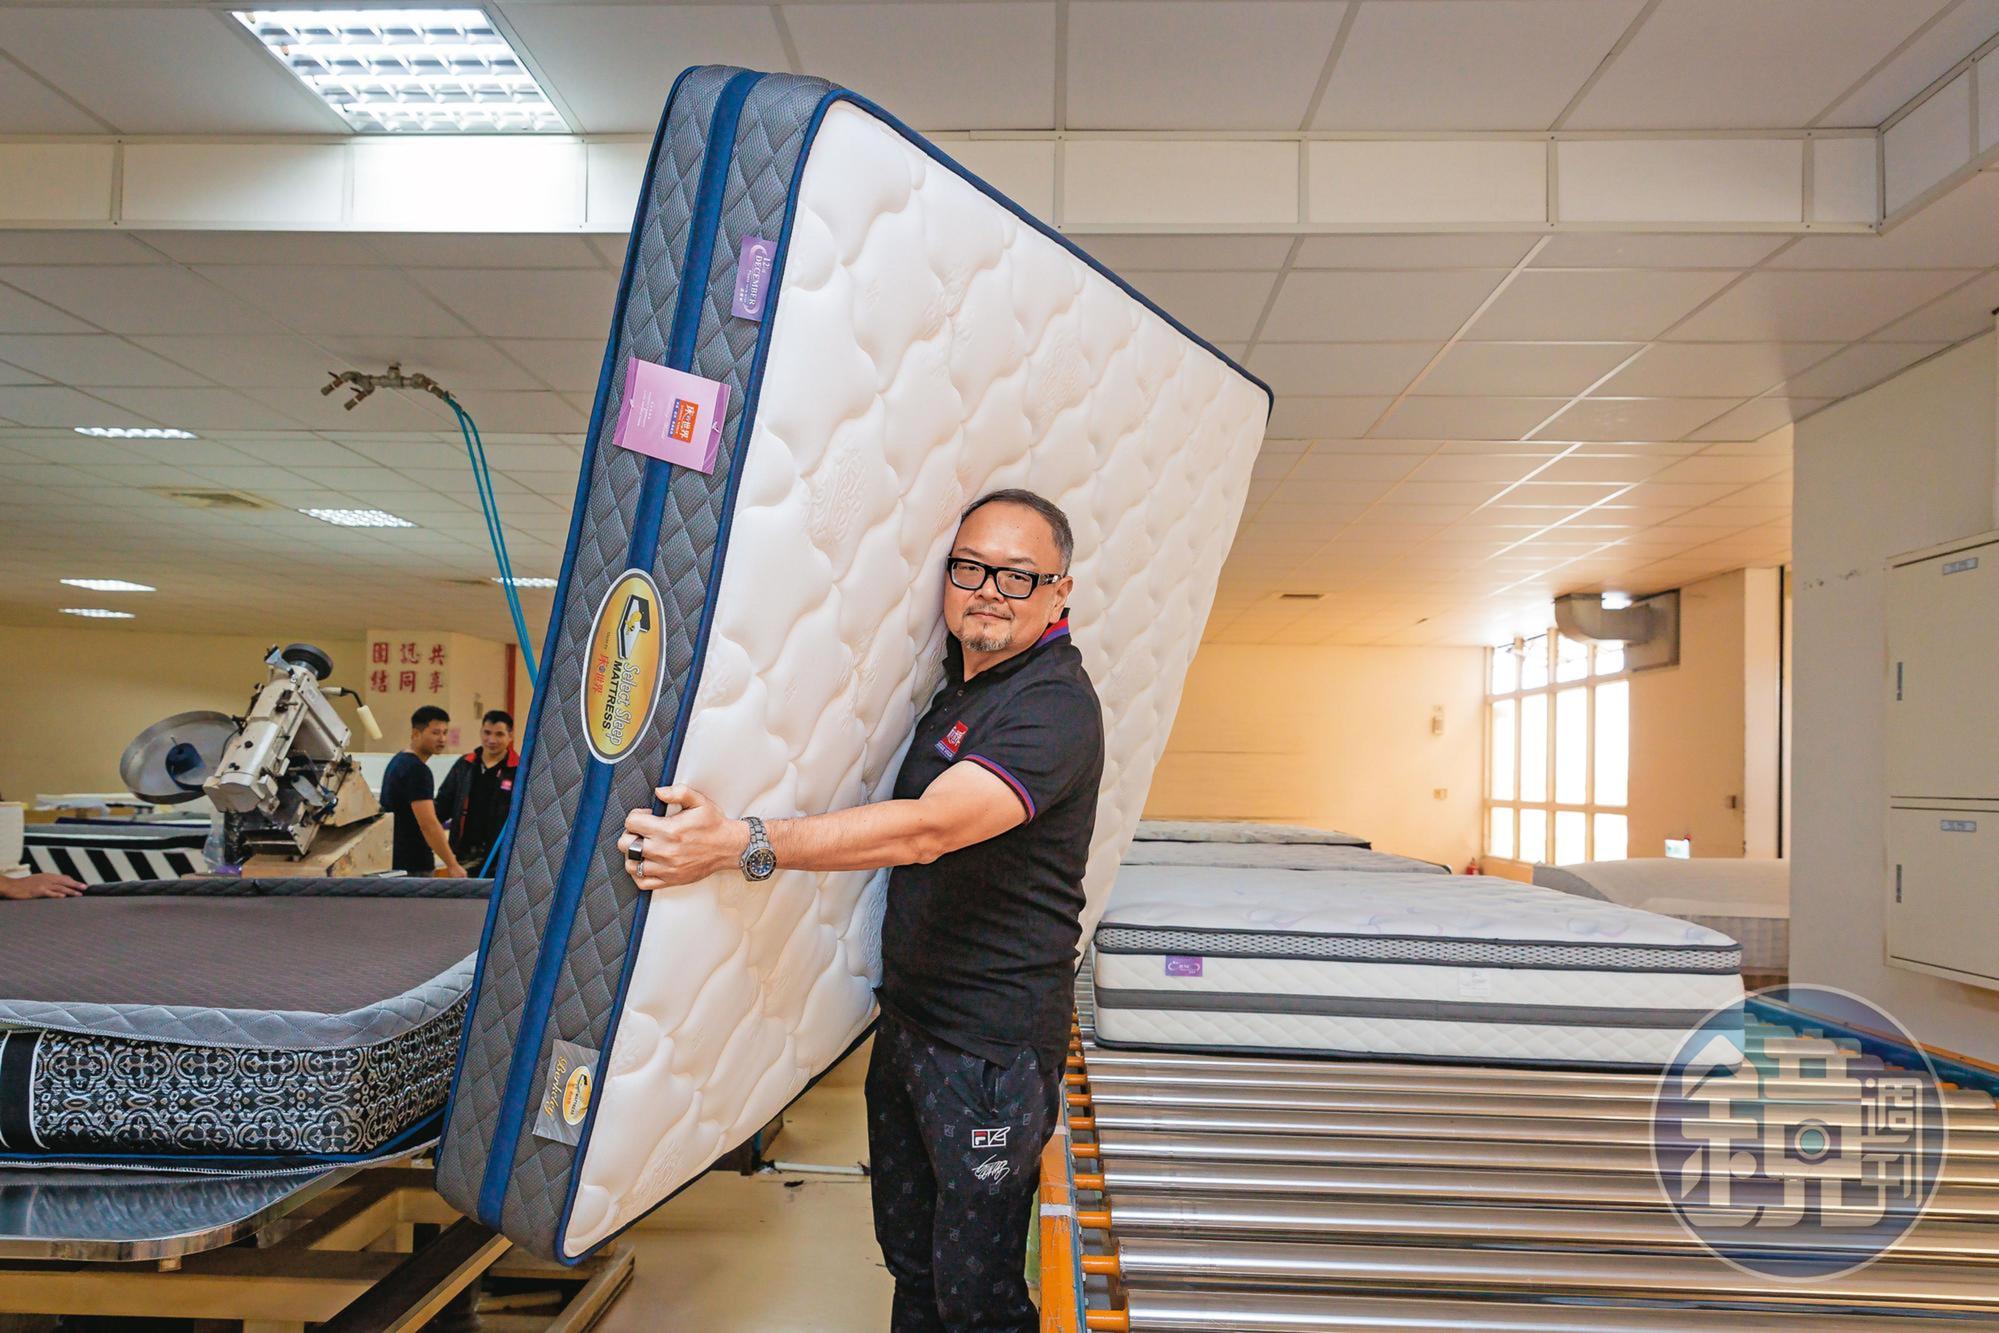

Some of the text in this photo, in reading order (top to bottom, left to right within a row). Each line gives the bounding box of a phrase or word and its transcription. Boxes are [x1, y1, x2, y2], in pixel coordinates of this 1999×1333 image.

[750, 256, 763, 305] DECEMBER
[602, 660, 622, 729] MATTRESS
[606, 663, 640, 745] Select Sleep
[544, 1056, 567, 1116] Berkeley
